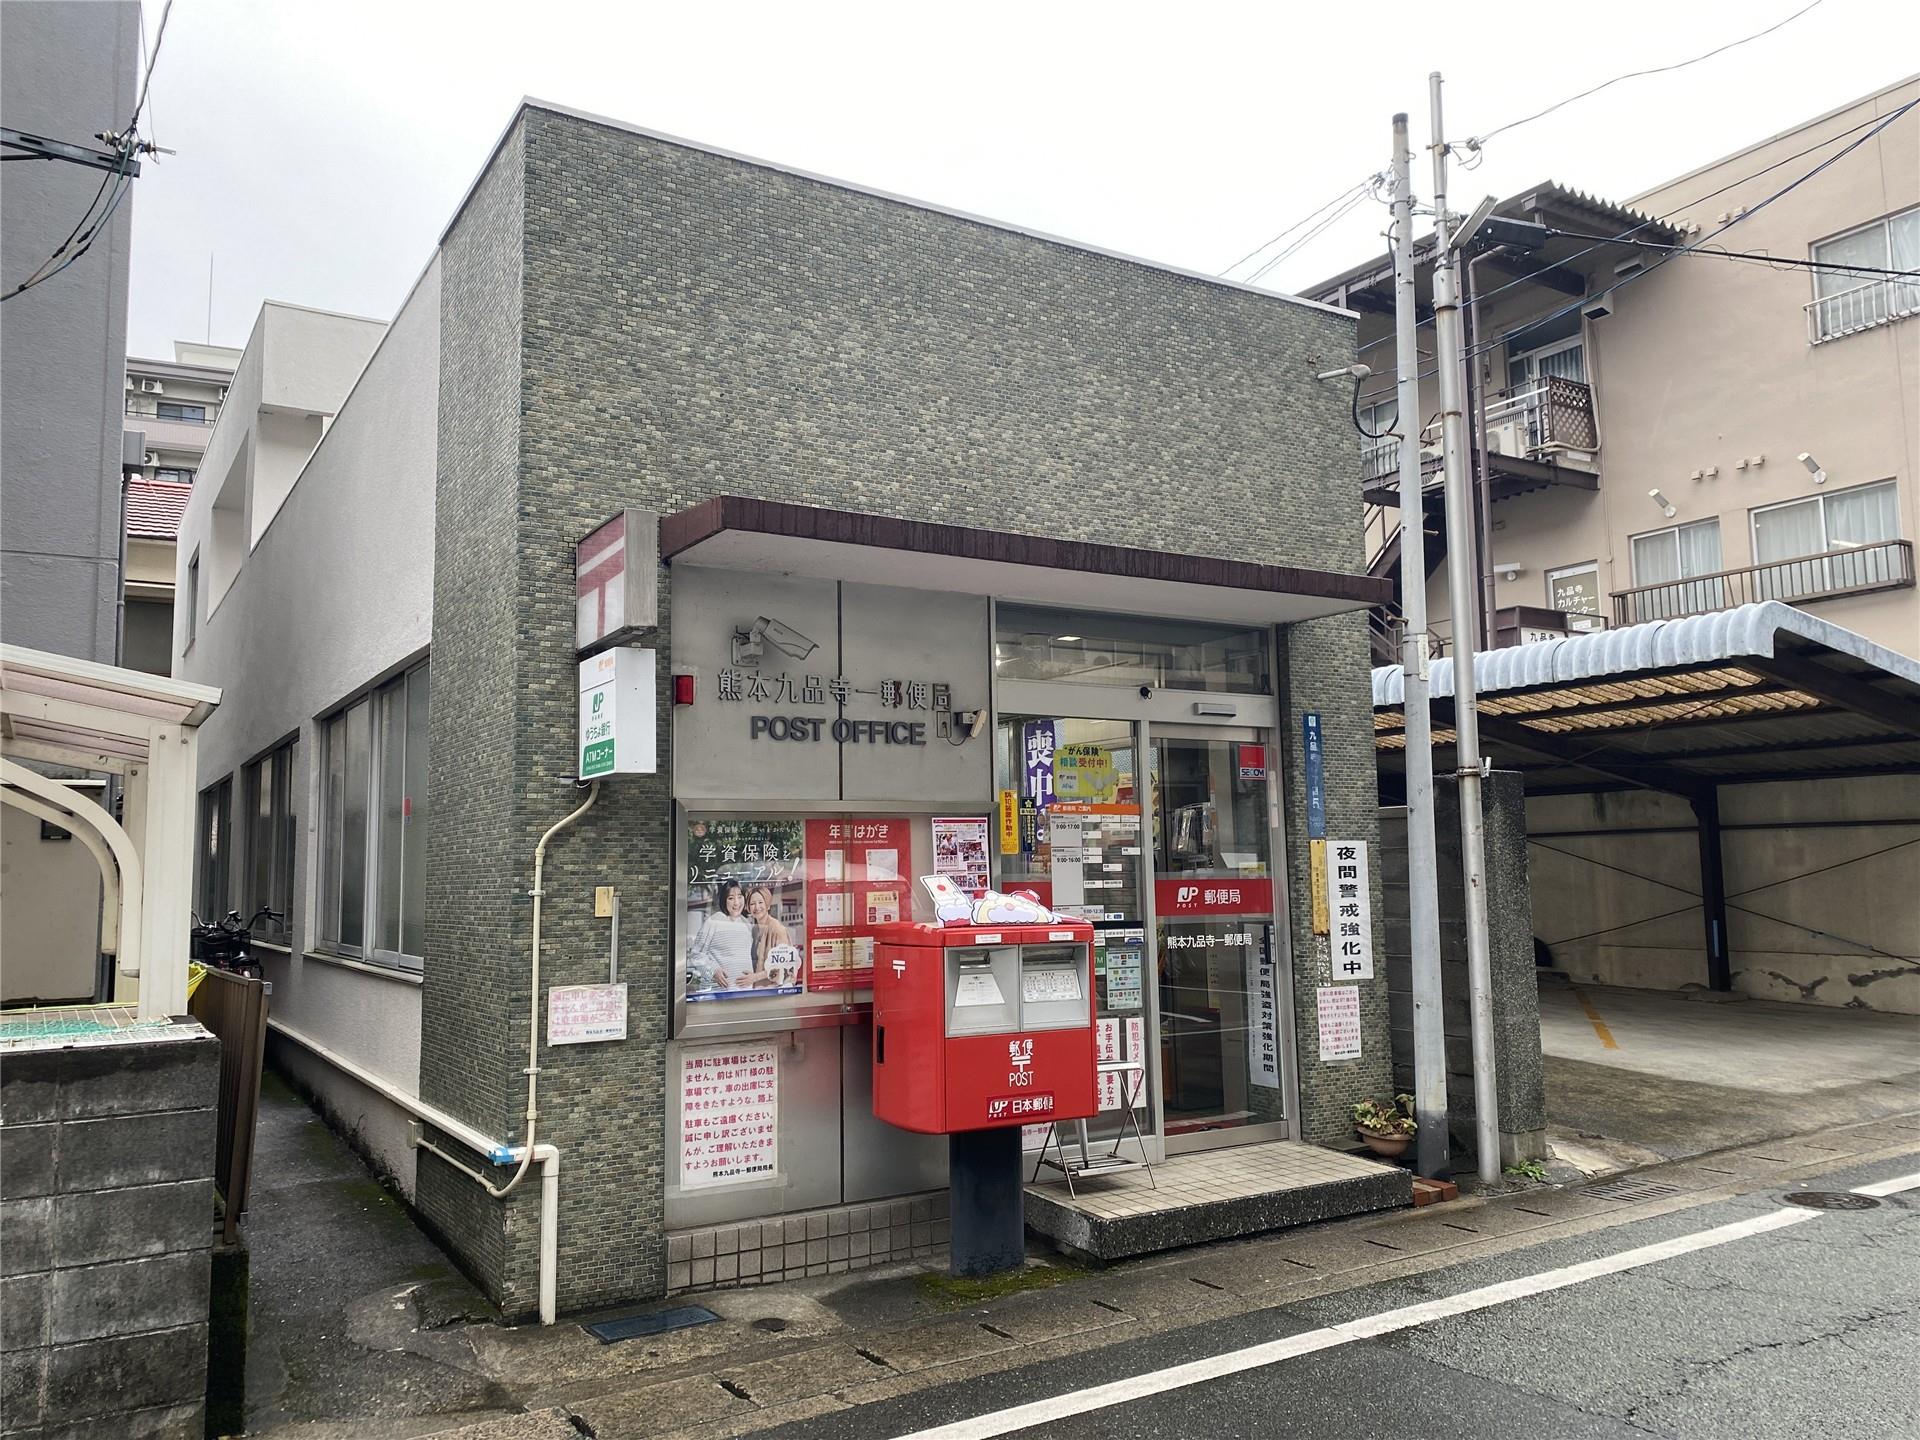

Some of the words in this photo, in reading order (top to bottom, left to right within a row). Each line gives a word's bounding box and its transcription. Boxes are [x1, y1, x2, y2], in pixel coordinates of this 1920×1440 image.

[1557, 584, 1583, 597] 九品寺
[1557, 596, 1595, 608] カルチャー
[718, 669, 952, 711] 熊本九品寺一郵便局
[751, 715, 826, 742] POST
[832, 718, 927, 745] OFFICE
[585, 746, 613, 763] ATMコーナー
[1241, 768, 1264, 777] SECOM
[829, 824, 889, 839] 年賀はがき
[699, 844, 792, 862] 学資保険を
[1204, 889, 1241, 905] 郵便局
[1336, 846, 1362, 976] 夜間警戒強化中
[1167, 934, 1252, 950] 熊本九品寺一郵便局
[771, 951, 795, 963] No.1
[1009, 1039, 1033, 1057] 郵便
[685, 1053, 774, 1069] 当局に駐車場はござい
[1104, 1023, 1115, 1106] お手伝要な方
[1131, 1021, 1142, 1101] 防犯カメ作動中
[1009, 1071, 1034, 1087] POST
[1012, 1096, 1053, 1113] 日本郵便
